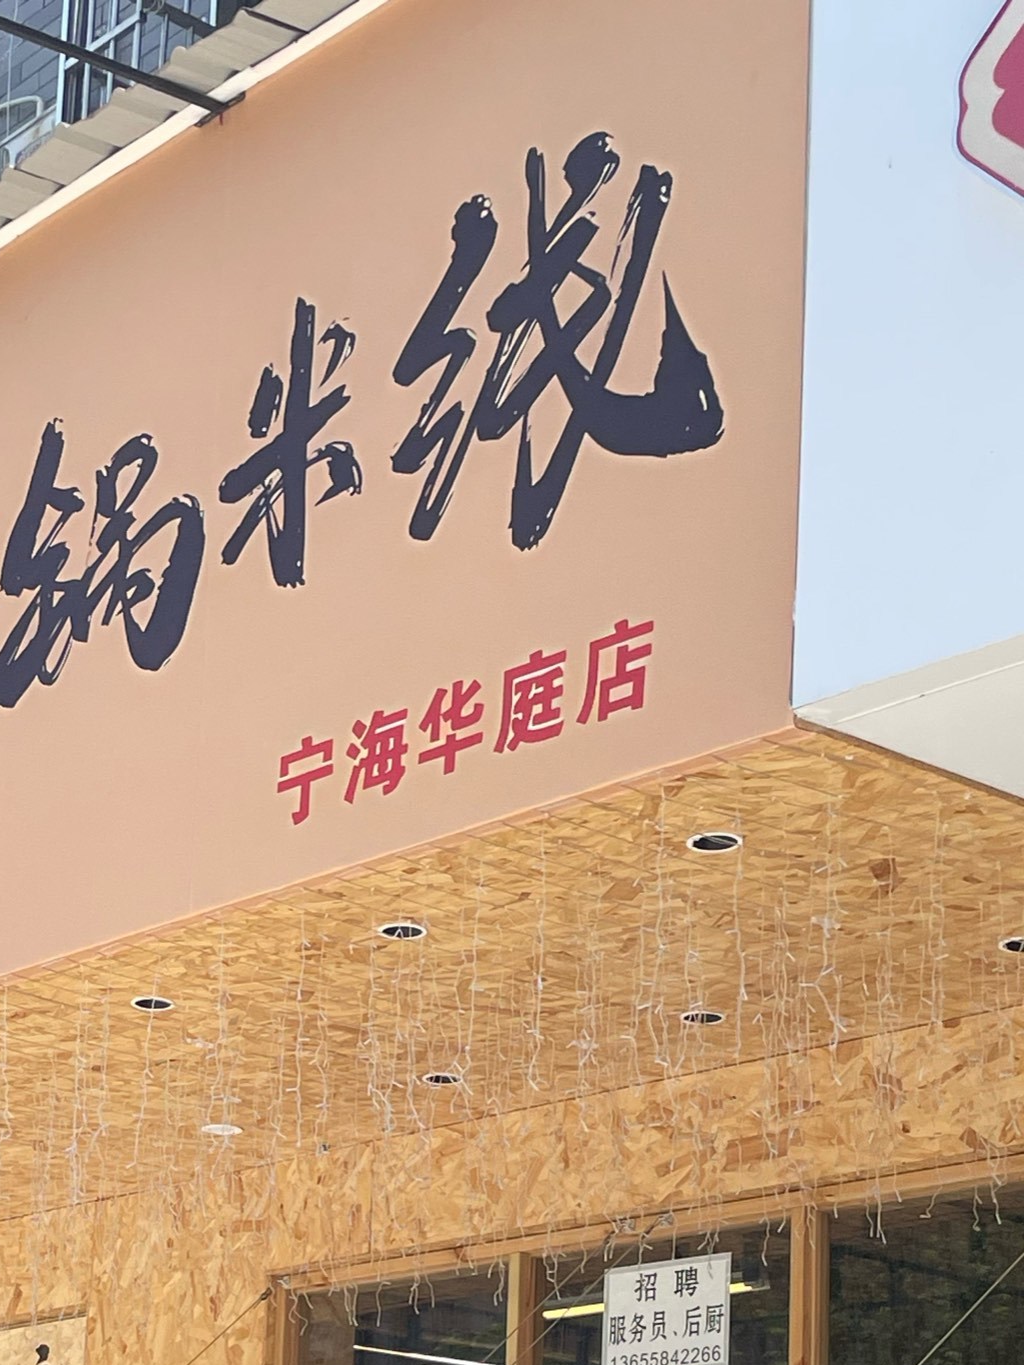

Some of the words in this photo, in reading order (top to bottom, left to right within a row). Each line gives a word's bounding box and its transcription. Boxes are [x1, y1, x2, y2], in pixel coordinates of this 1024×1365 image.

[276, 619, 654, 826] 宁海华庭店
[634, 1266, 699, 1303] 招聘
[609, 1304, 724, 1346] 服务员、后厨
